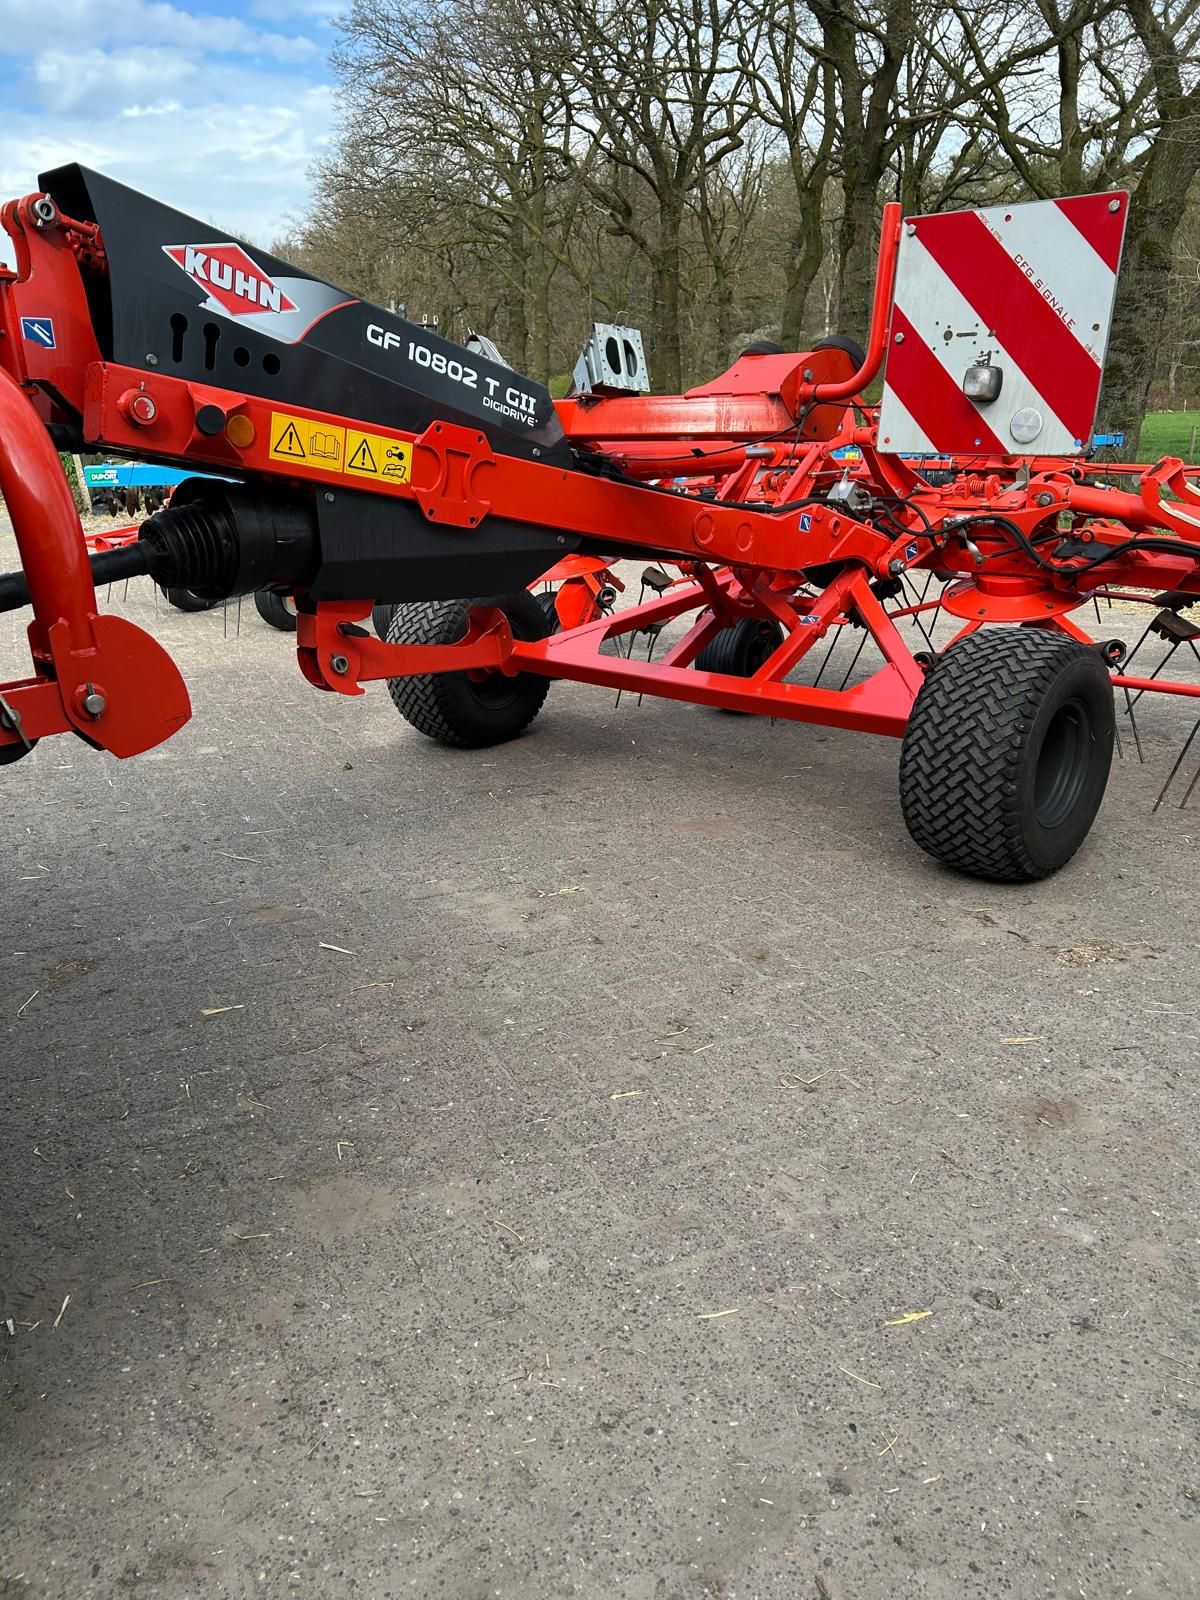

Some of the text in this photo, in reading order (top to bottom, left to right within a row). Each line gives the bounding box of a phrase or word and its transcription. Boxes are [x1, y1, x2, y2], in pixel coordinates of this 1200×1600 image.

[184, 246, 281, 313] KUHN
[1014, 254, 1034, 278] CFG
[366, 323, 537, 415] GF 10802 T GII
[482, 396, 535, 427] DIGIDRIVE
